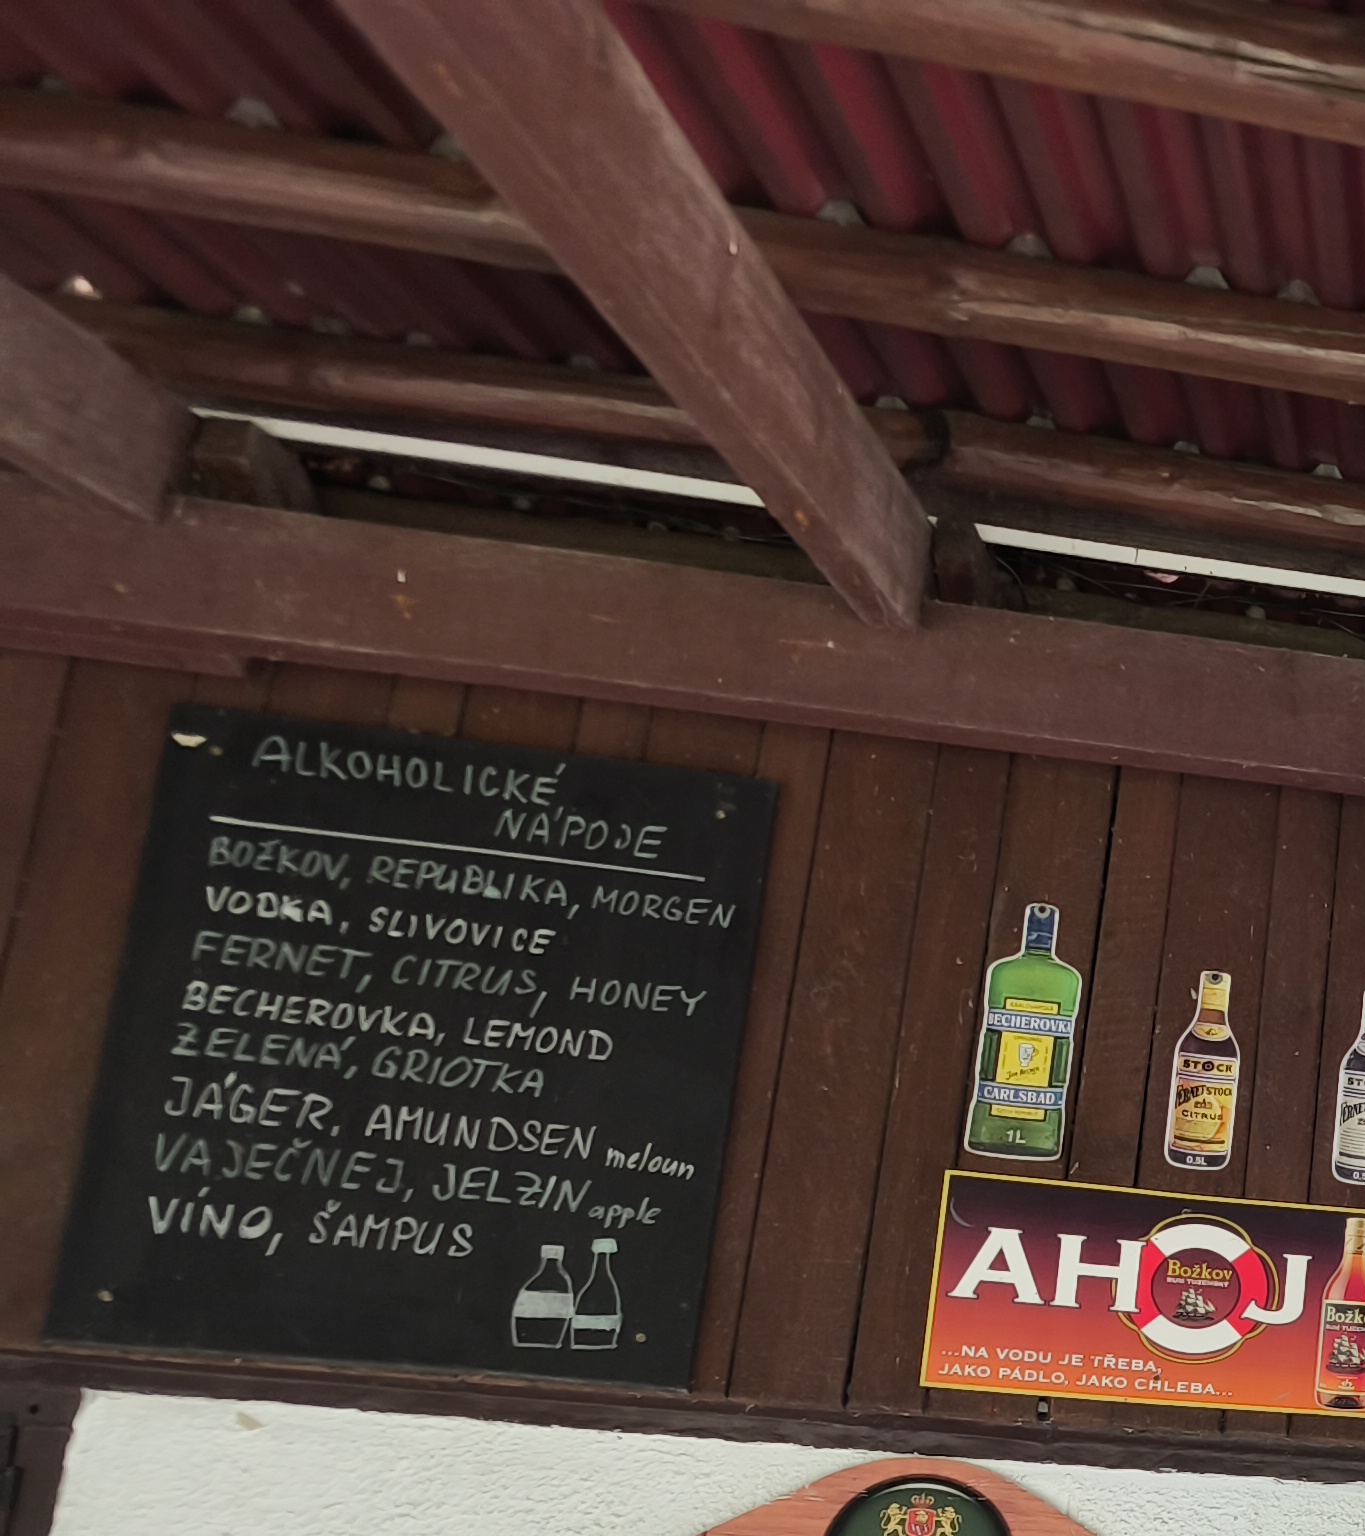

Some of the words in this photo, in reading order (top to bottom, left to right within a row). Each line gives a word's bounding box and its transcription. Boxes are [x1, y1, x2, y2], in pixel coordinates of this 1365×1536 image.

[251, 735, 567, 806] ALKOHOLICKÉ
[494, 805, 668, 859] NÁPOJE
[209, 836, 352, 890] BOŽKOV,
[368, 855, 582, 919] REPUBLIKA,
[592, 885, 736, 929] MORGEN
[205, 885, 350, 934] VODKA,
[369, 906, 557, 955] SLIVOVICE
[191, 931, 374, 992] FERNET,
[391, 955, 550, 1017] CITRUS,
[570, 976, 709, 1018] HONEY
[183, 980, 447, 1047] BECHEROVKA,
[463, 1018, 614, 1061] LEMOND
[371, 1047, 546, 1098] GRIOTKA
[984, 1086, 1055, 1104] CARLSBAD
[1183, 1059, 1233, 1073] STOCK
[365, 1104, 598, 1161] AMUNDSEN
[605, 1141, 696, 1182] meloun
[1006, 1129, 1027, 1144] 1L
[1182, 1109, 1223, 1120] CITRUS
[147, 1184, 286, 1257] VÍNO,
[308, 1200, 476, 1258] ŠAMPUS
[431, 1163, 592, 1214] JELZIN
[588, 1196, 662, 1229] apple
[947, 1223, 1313, 1354] AHOJ
[1166, 1258, 1233, 1283] Božkov
[938, 1364, 991, 1378] JAKO
[998, 1364, 1070, 1385] PÁDLO,
[1076, 1374, 1128, 1389] JAKO
[996, 1348, 1052, 1364] VODU
[1058, 1353, 1085, 1366] JE
[1090, 1353, 1163, 1374] TŘEBA,
